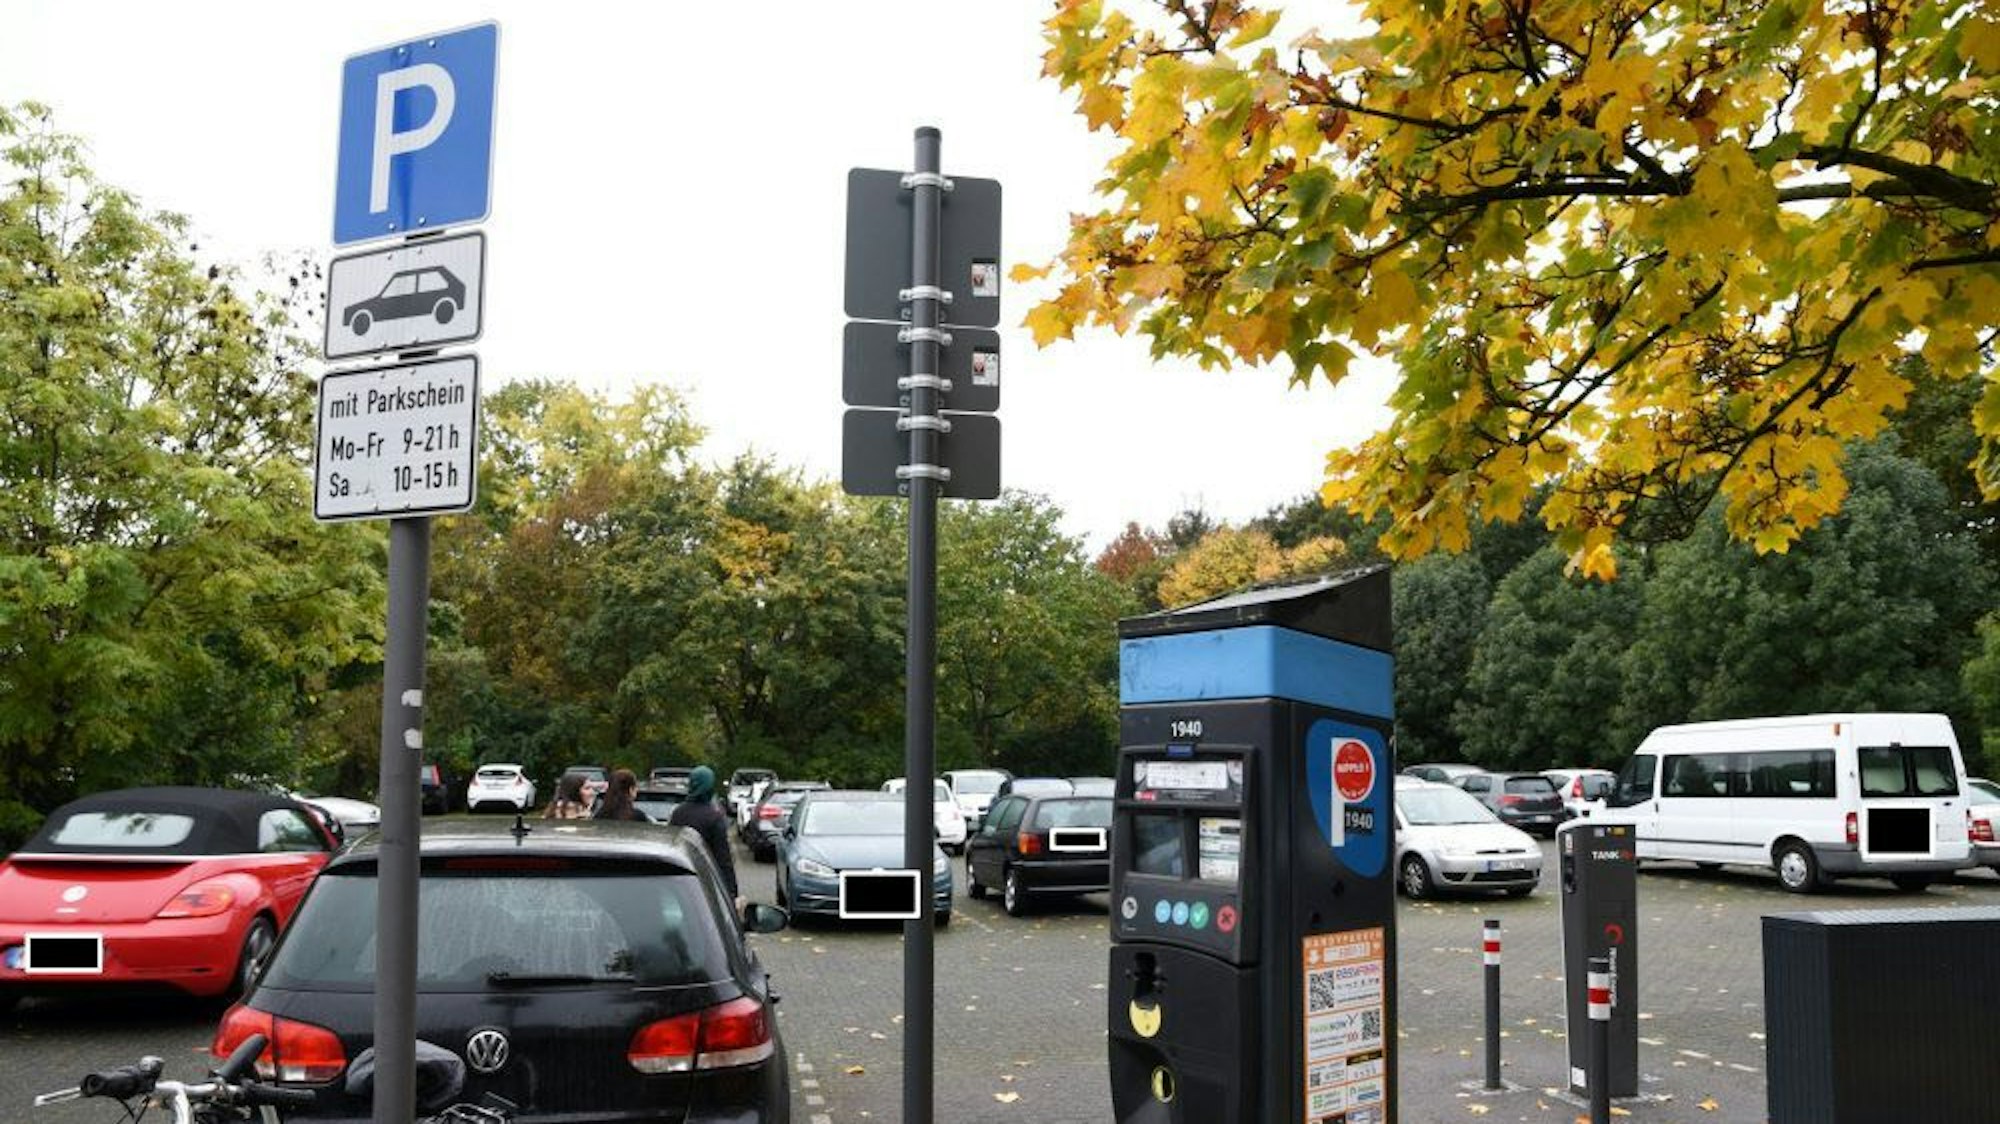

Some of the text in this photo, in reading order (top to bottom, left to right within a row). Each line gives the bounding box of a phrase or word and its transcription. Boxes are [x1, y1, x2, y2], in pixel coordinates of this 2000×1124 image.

[369, 62, 456, 214] P
[330, 378, 465, 418] mit Parkschein
[331, 424, 459, 461] Mo-Fr 9-21 h
[329, 461, 458, 497] Sa 10-15 h
[1171, 720, 1203, 737] 1940
[1345, 811, 1374, 830] 1940
